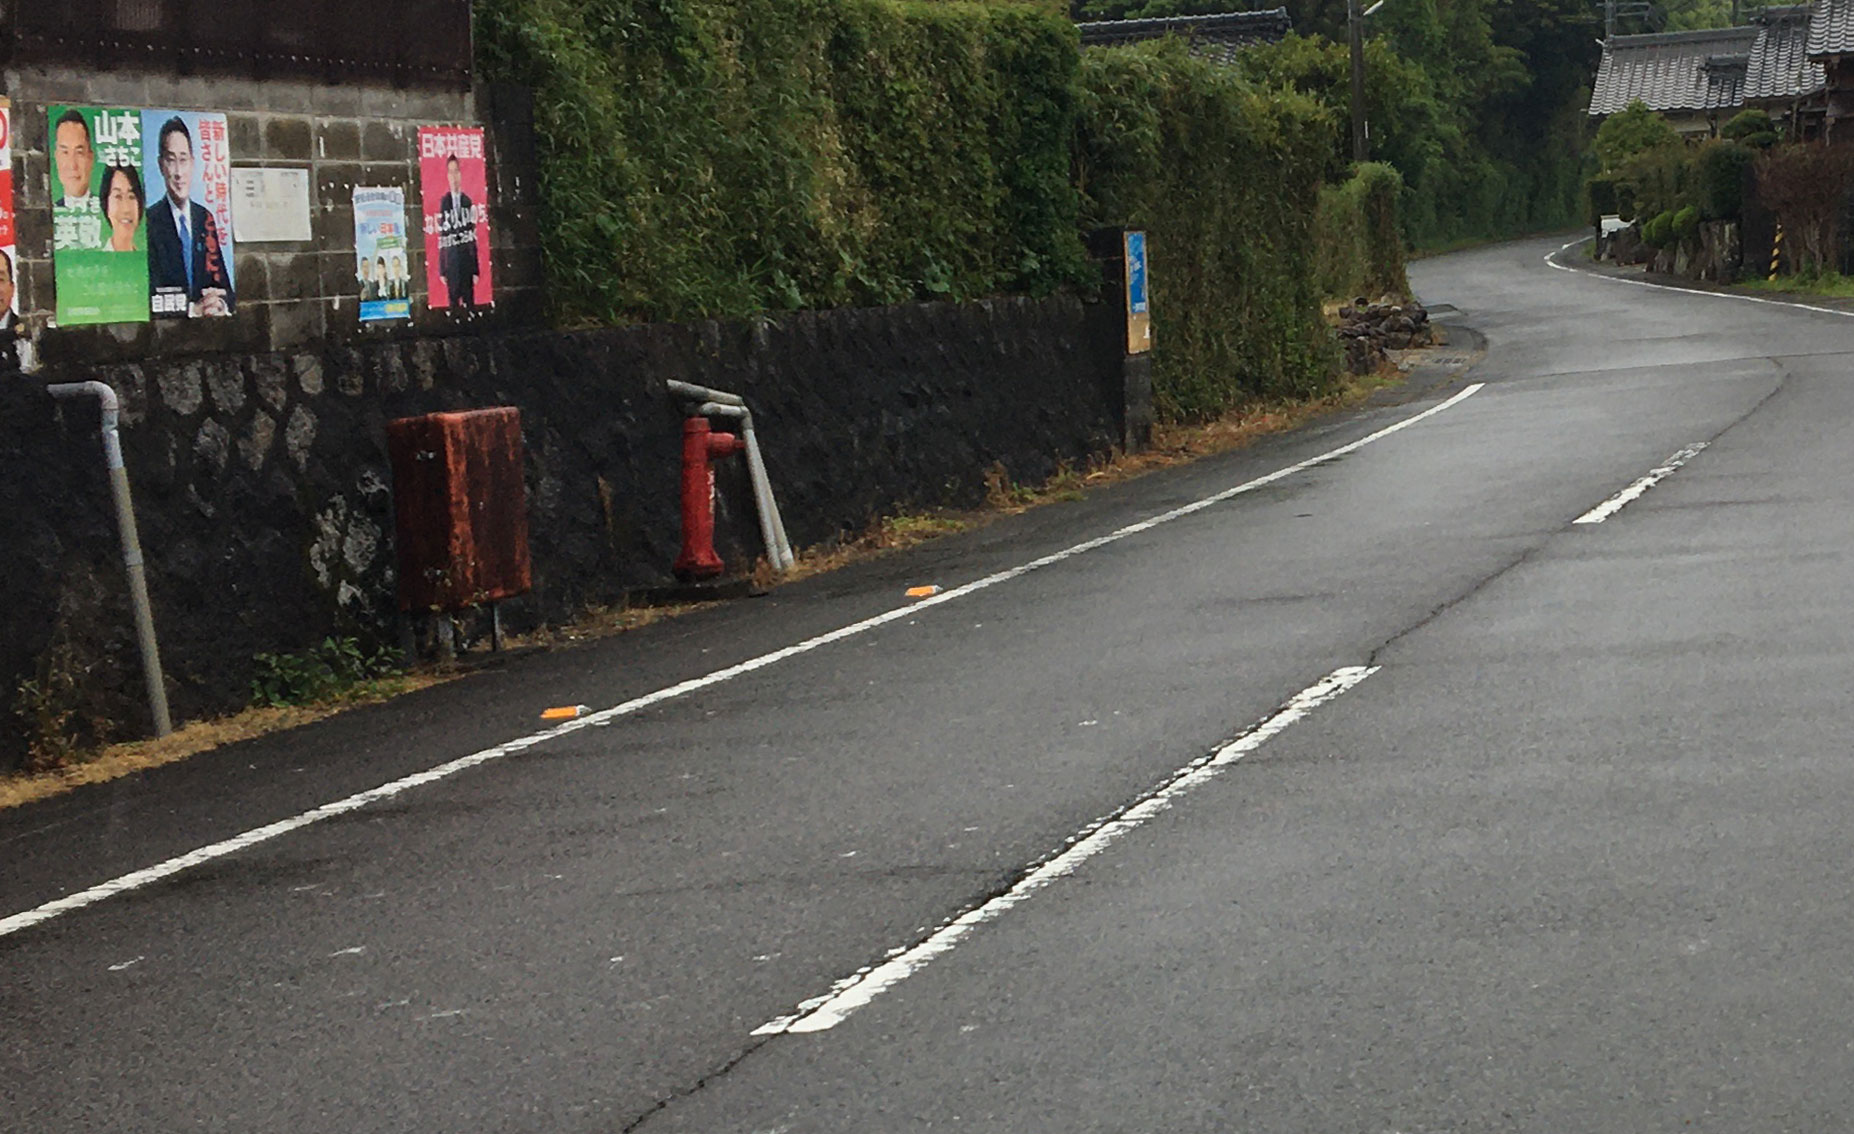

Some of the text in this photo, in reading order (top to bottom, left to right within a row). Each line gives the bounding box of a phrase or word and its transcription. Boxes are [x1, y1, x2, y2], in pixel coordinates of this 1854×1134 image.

[94, 110, 140, 145] 山本
[104, 147, 142, 167] さちこ
[422, 133, 482, 159] 日本共産党
